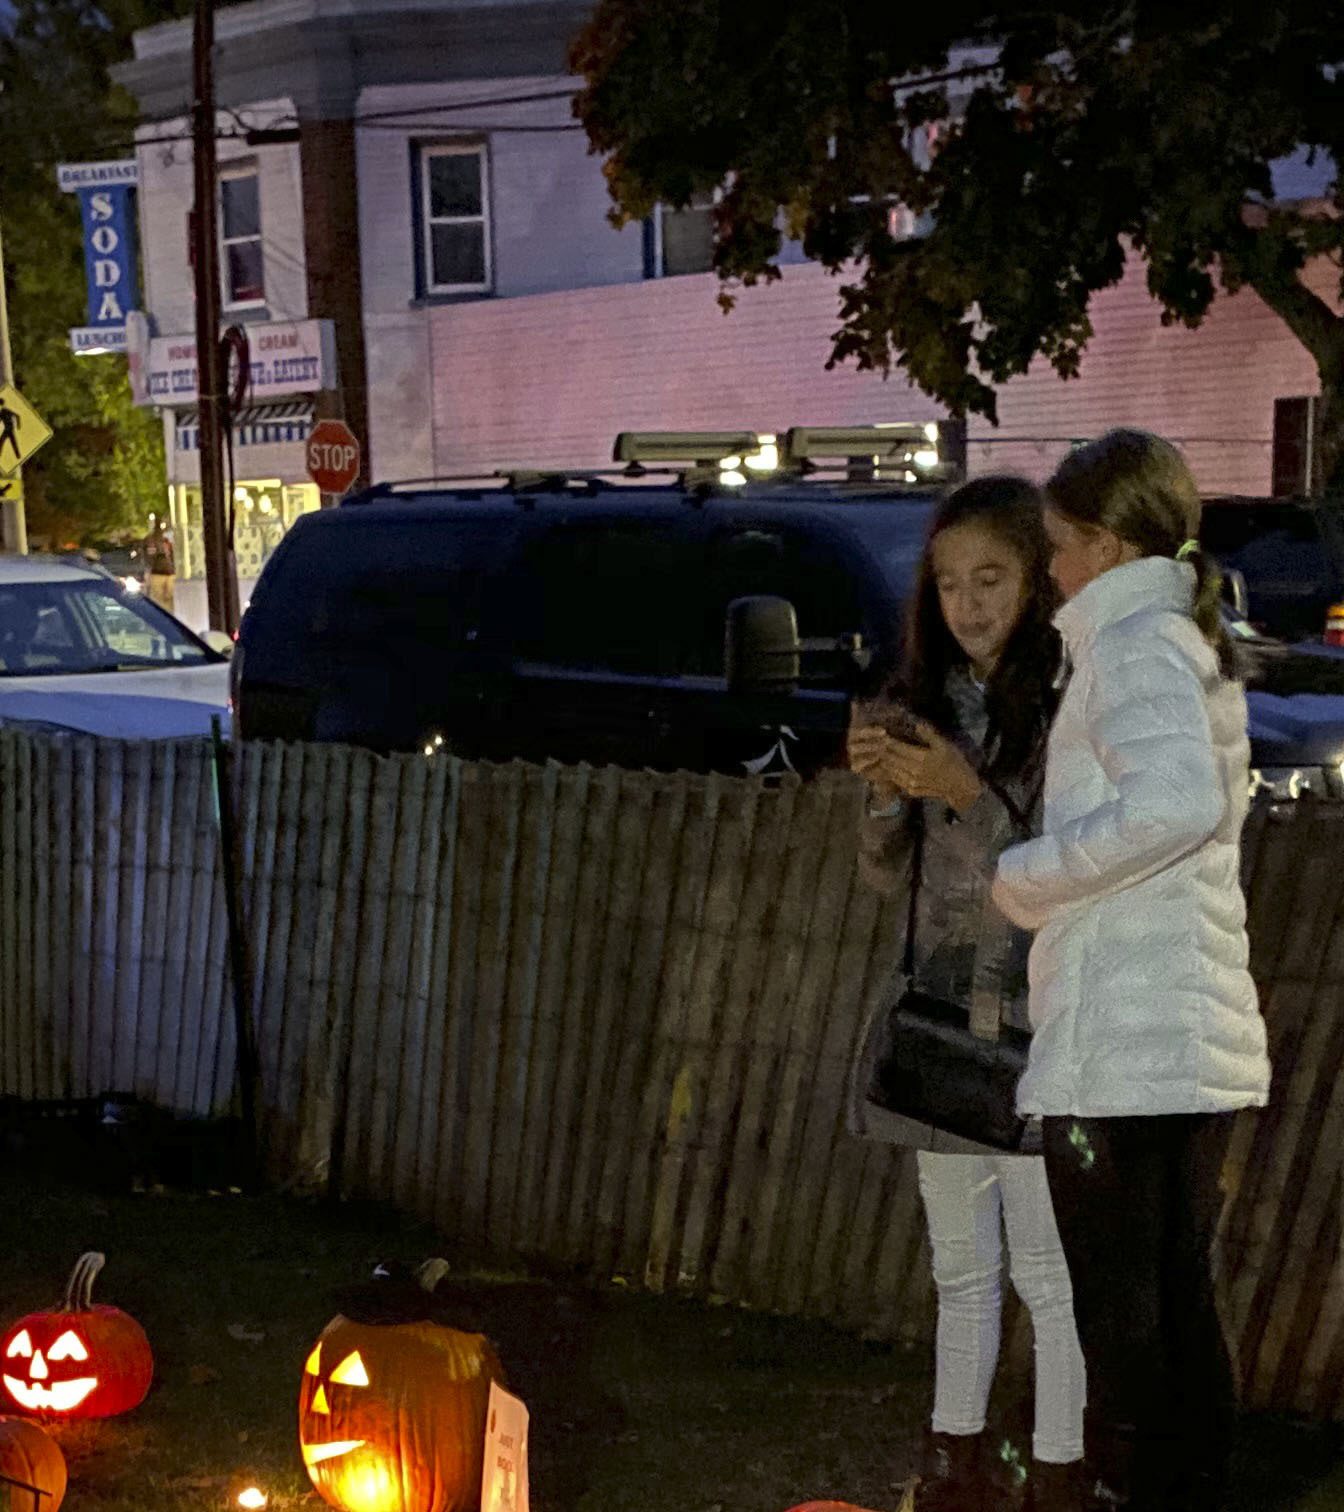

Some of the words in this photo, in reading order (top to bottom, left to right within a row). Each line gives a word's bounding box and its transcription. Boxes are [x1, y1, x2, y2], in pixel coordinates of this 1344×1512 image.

[62, 165, 138, 184] BREAKFAST
[90, 192, 123, 321] SODA
[310, 443, 355, 471] STOP
